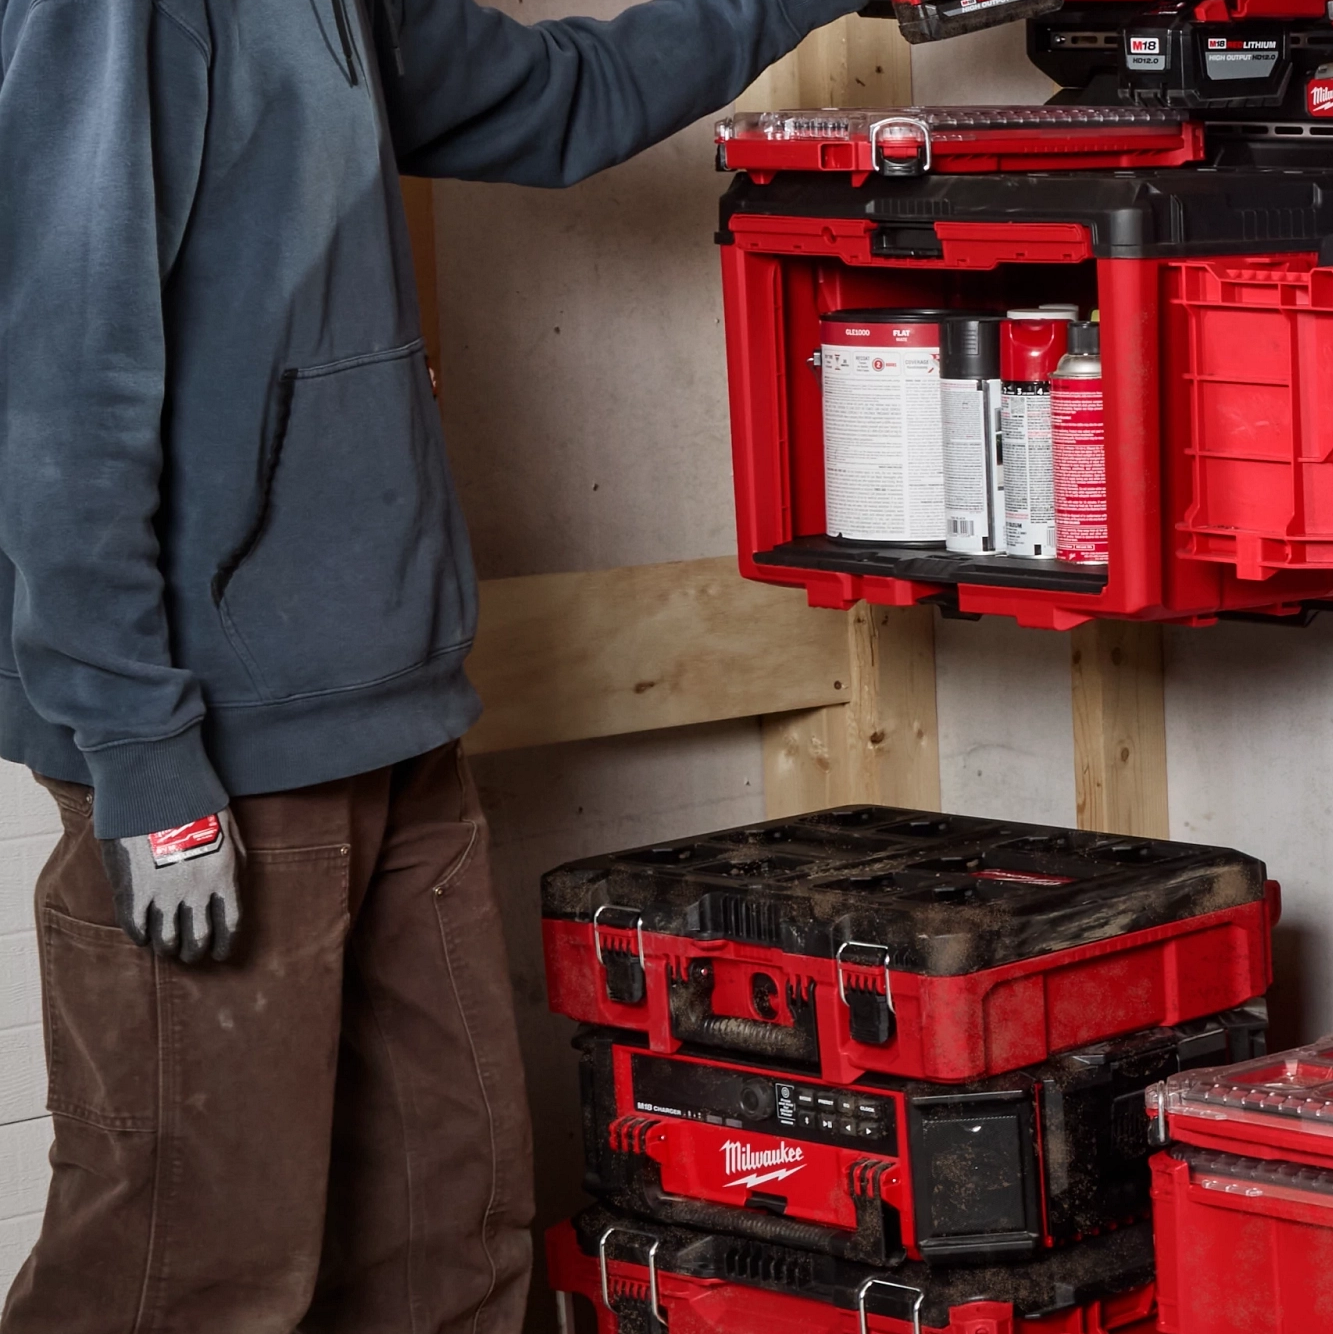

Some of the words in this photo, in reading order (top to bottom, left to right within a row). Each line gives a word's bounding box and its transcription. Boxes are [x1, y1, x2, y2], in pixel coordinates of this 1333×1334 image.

[1132, 40, 1157, 51] M18
[1226, 40, 1276, 49] REDLITHIUM
[892, 329, 911, 337] FLAT
[719, 1139, 804, 1176] Milwaukee
